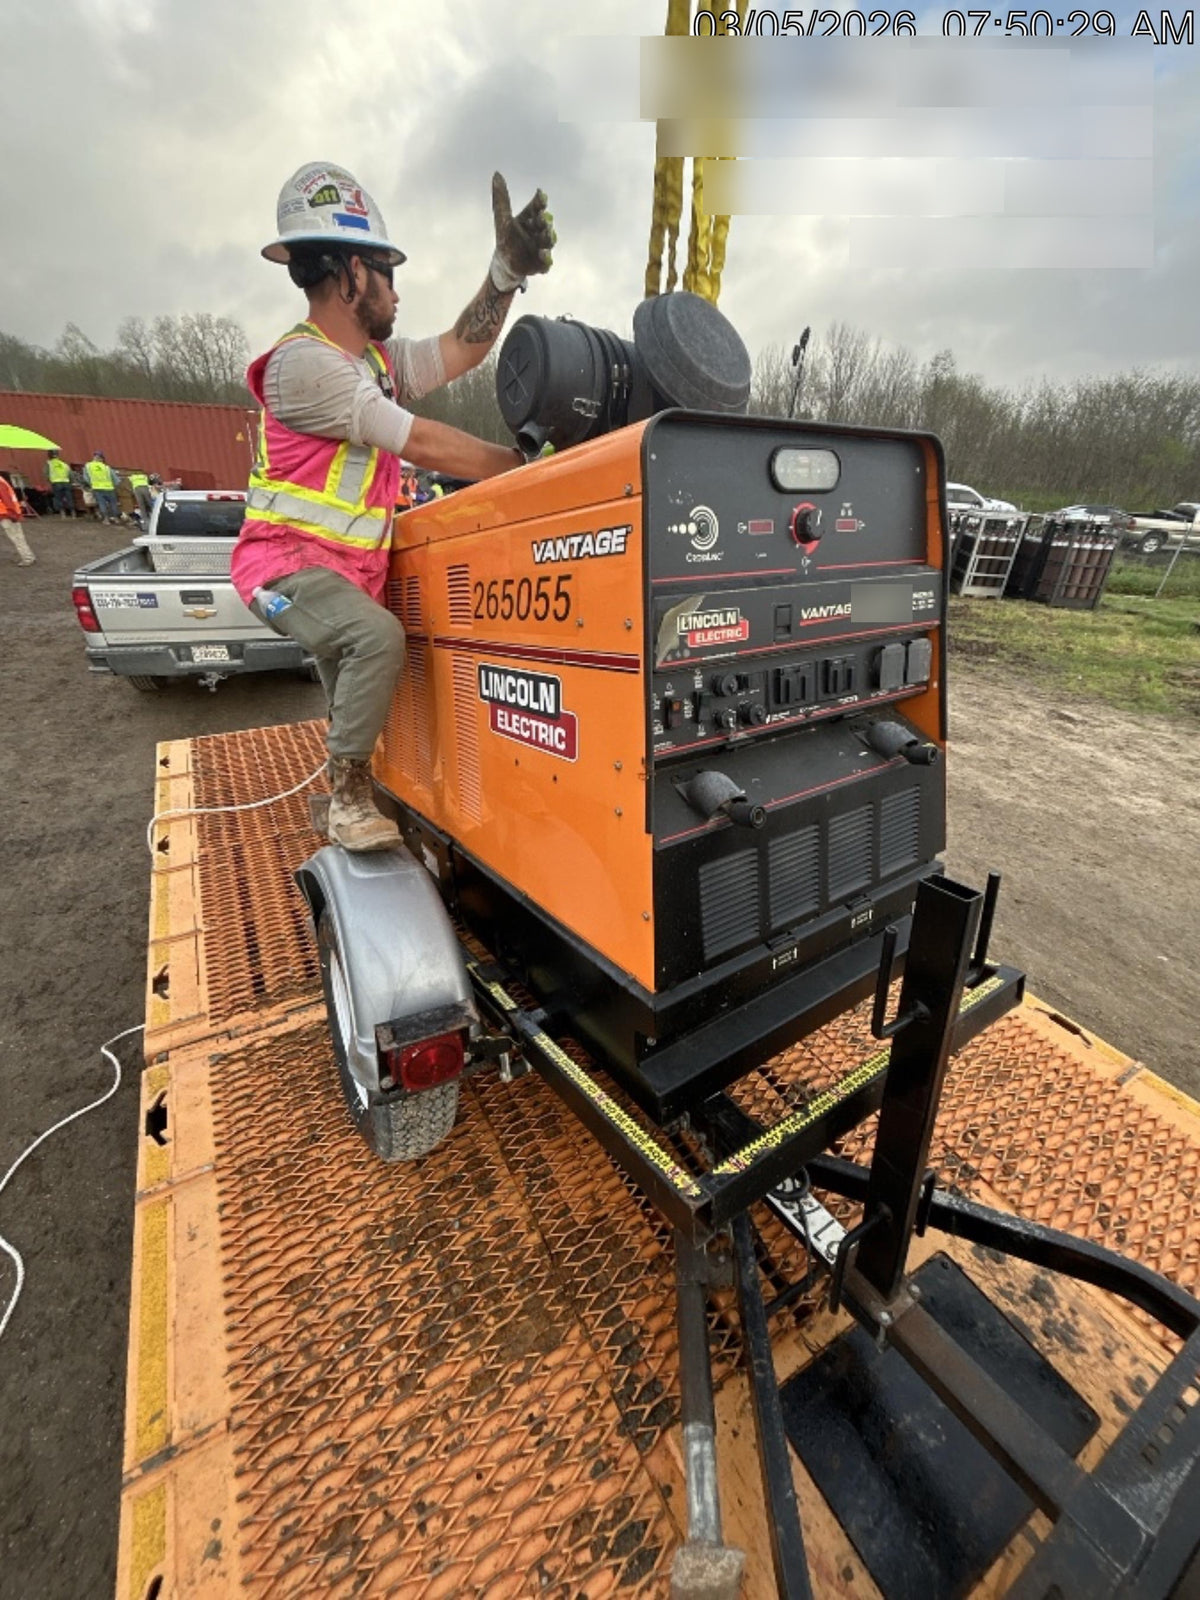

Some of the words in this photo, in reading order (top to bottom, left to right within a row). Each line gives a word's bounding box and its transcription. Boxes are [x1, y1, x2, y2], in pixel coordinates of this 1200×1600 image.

[532, 526, 628, 563] VANTAGE
[473, 574, 572, 622] 265055
[801, 604, 851, 619] VANTAG
[680, 610, 737, 631] LINCOLN
[695, 629, 742, 643] ELECTRIC
[481, 669, 556, 714] LINCOLN
[497, 708, 567, 751] ELECTRIC
